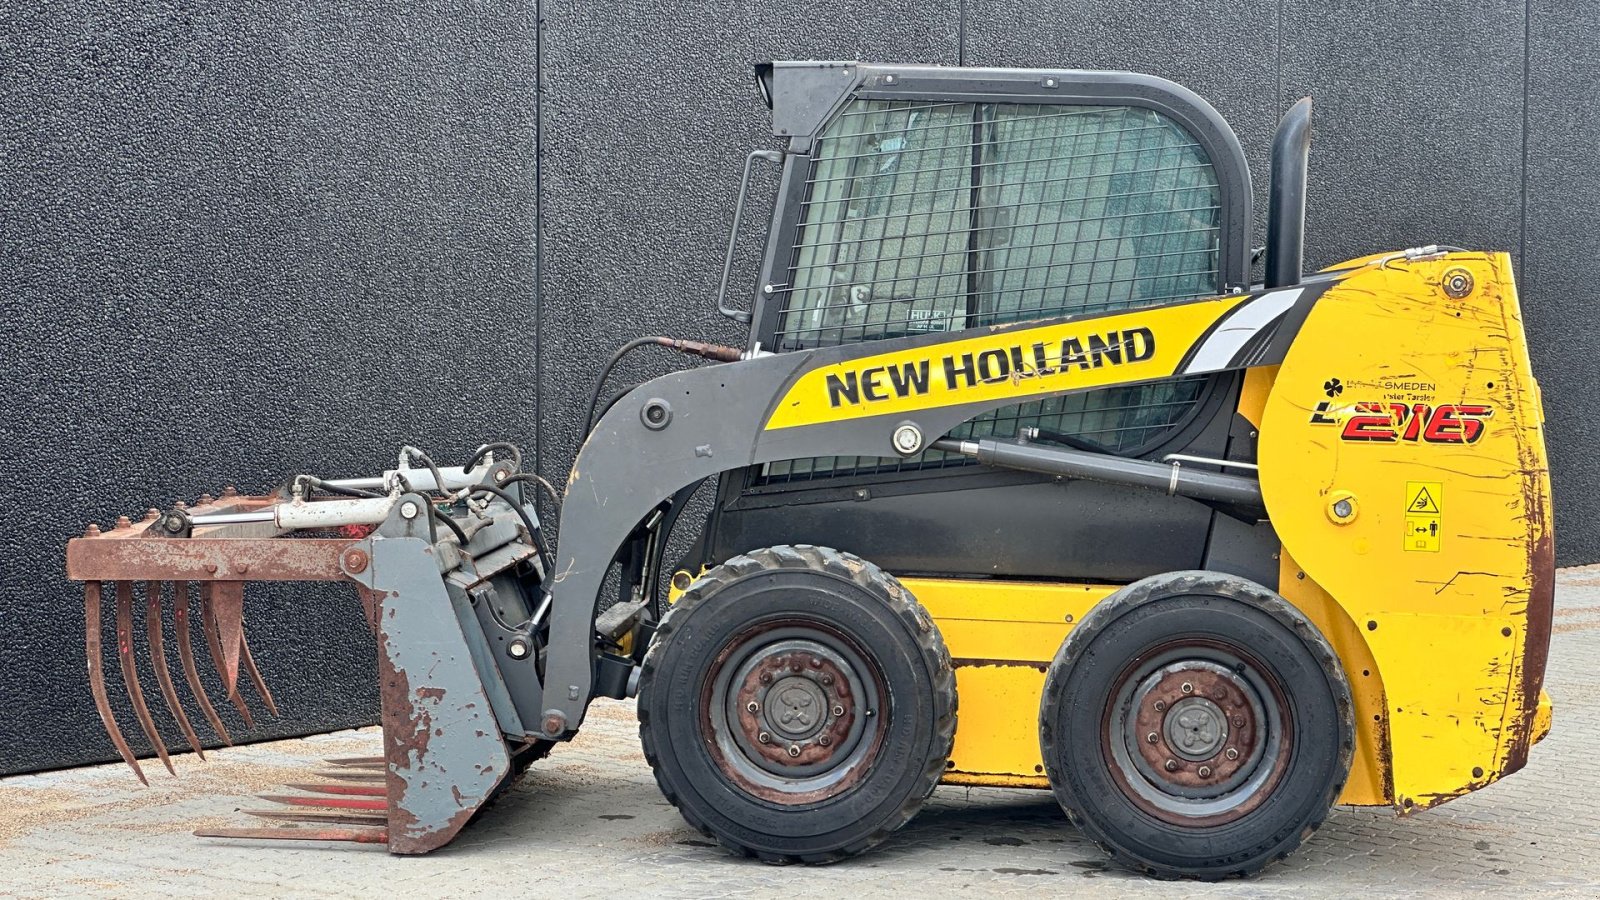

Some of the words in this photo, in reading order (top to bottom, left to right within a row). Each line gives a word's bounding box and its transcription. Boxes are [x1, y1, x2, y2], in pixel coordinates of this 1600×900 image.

[826, 359, 931, 408] NEW
[942, 327, 1156, 389] HOLLAND
[1384, 381, 1436, 391] SMEDEN
